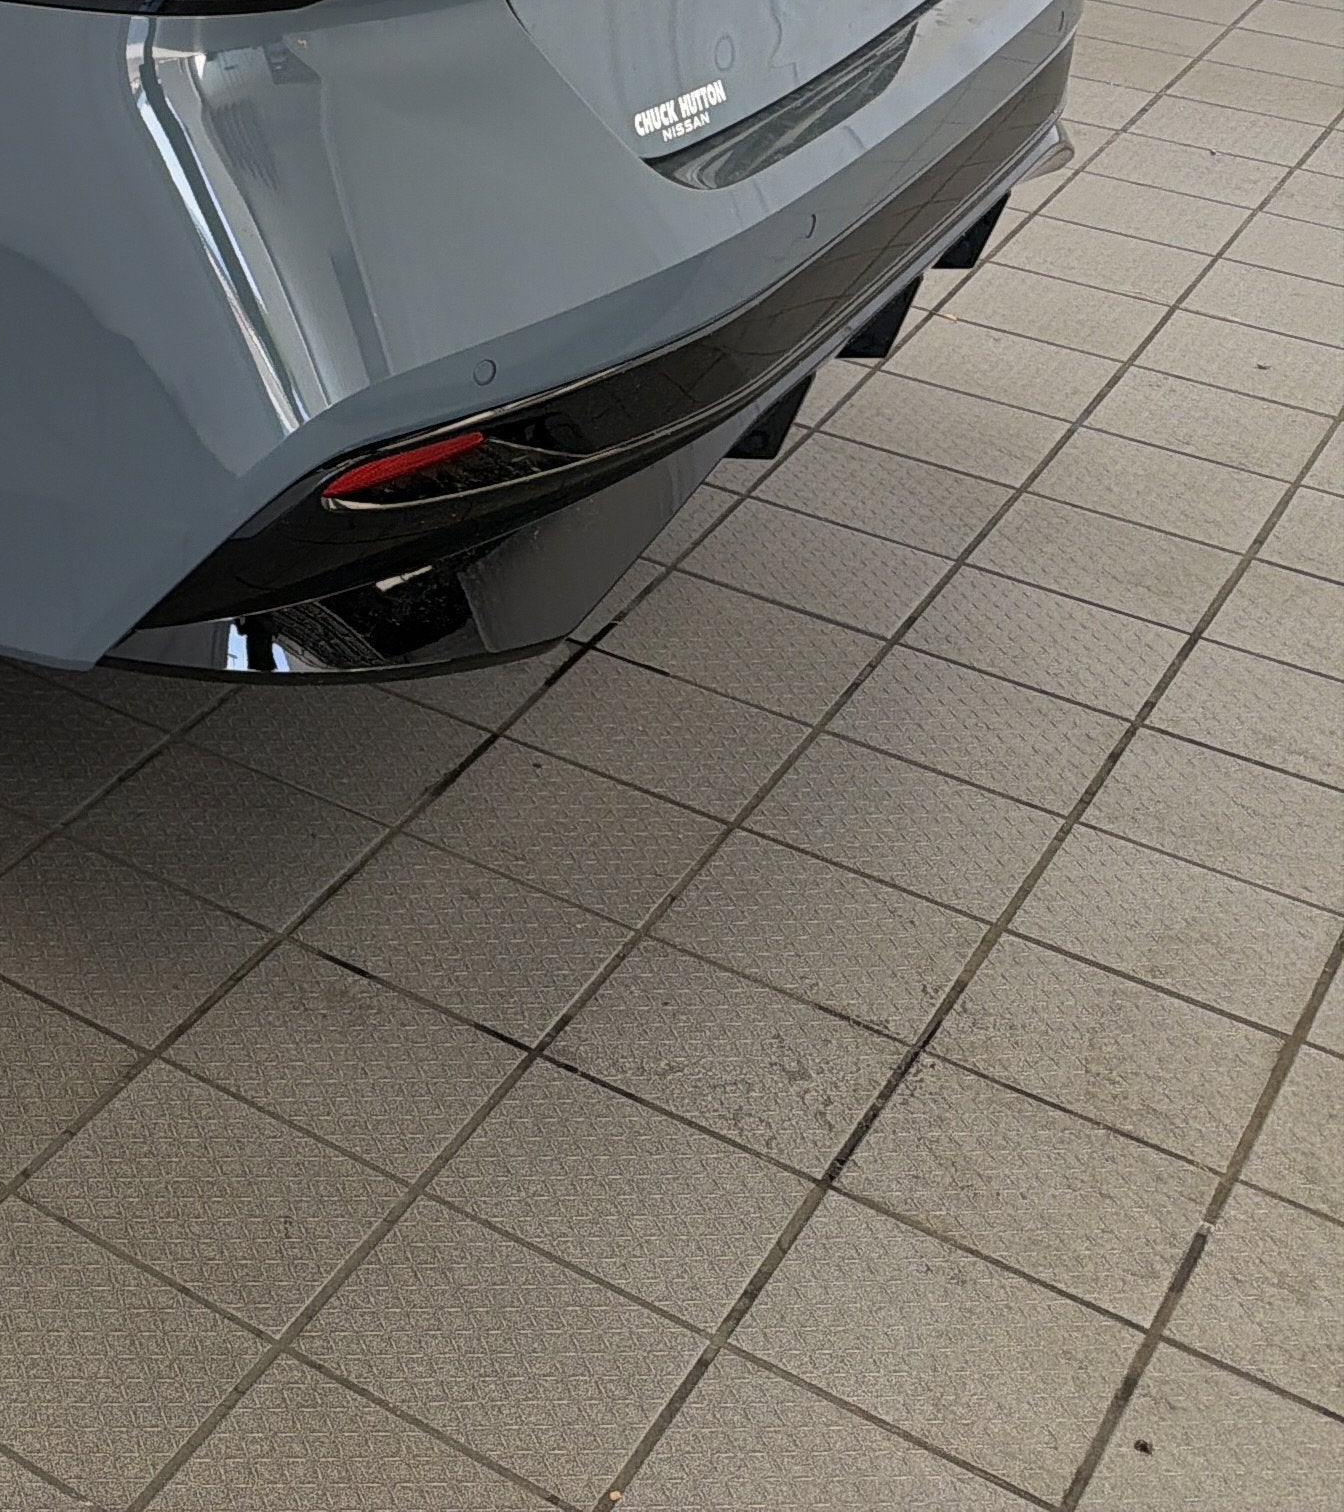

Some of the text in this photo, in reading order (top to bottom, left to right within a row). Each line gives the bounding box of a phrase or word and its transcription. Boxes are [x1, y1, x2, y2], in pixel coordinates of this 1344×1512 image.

[634, 79, 727, 137] CHUCK HUTTON
[662, 111, 710, 142] NISSAN
